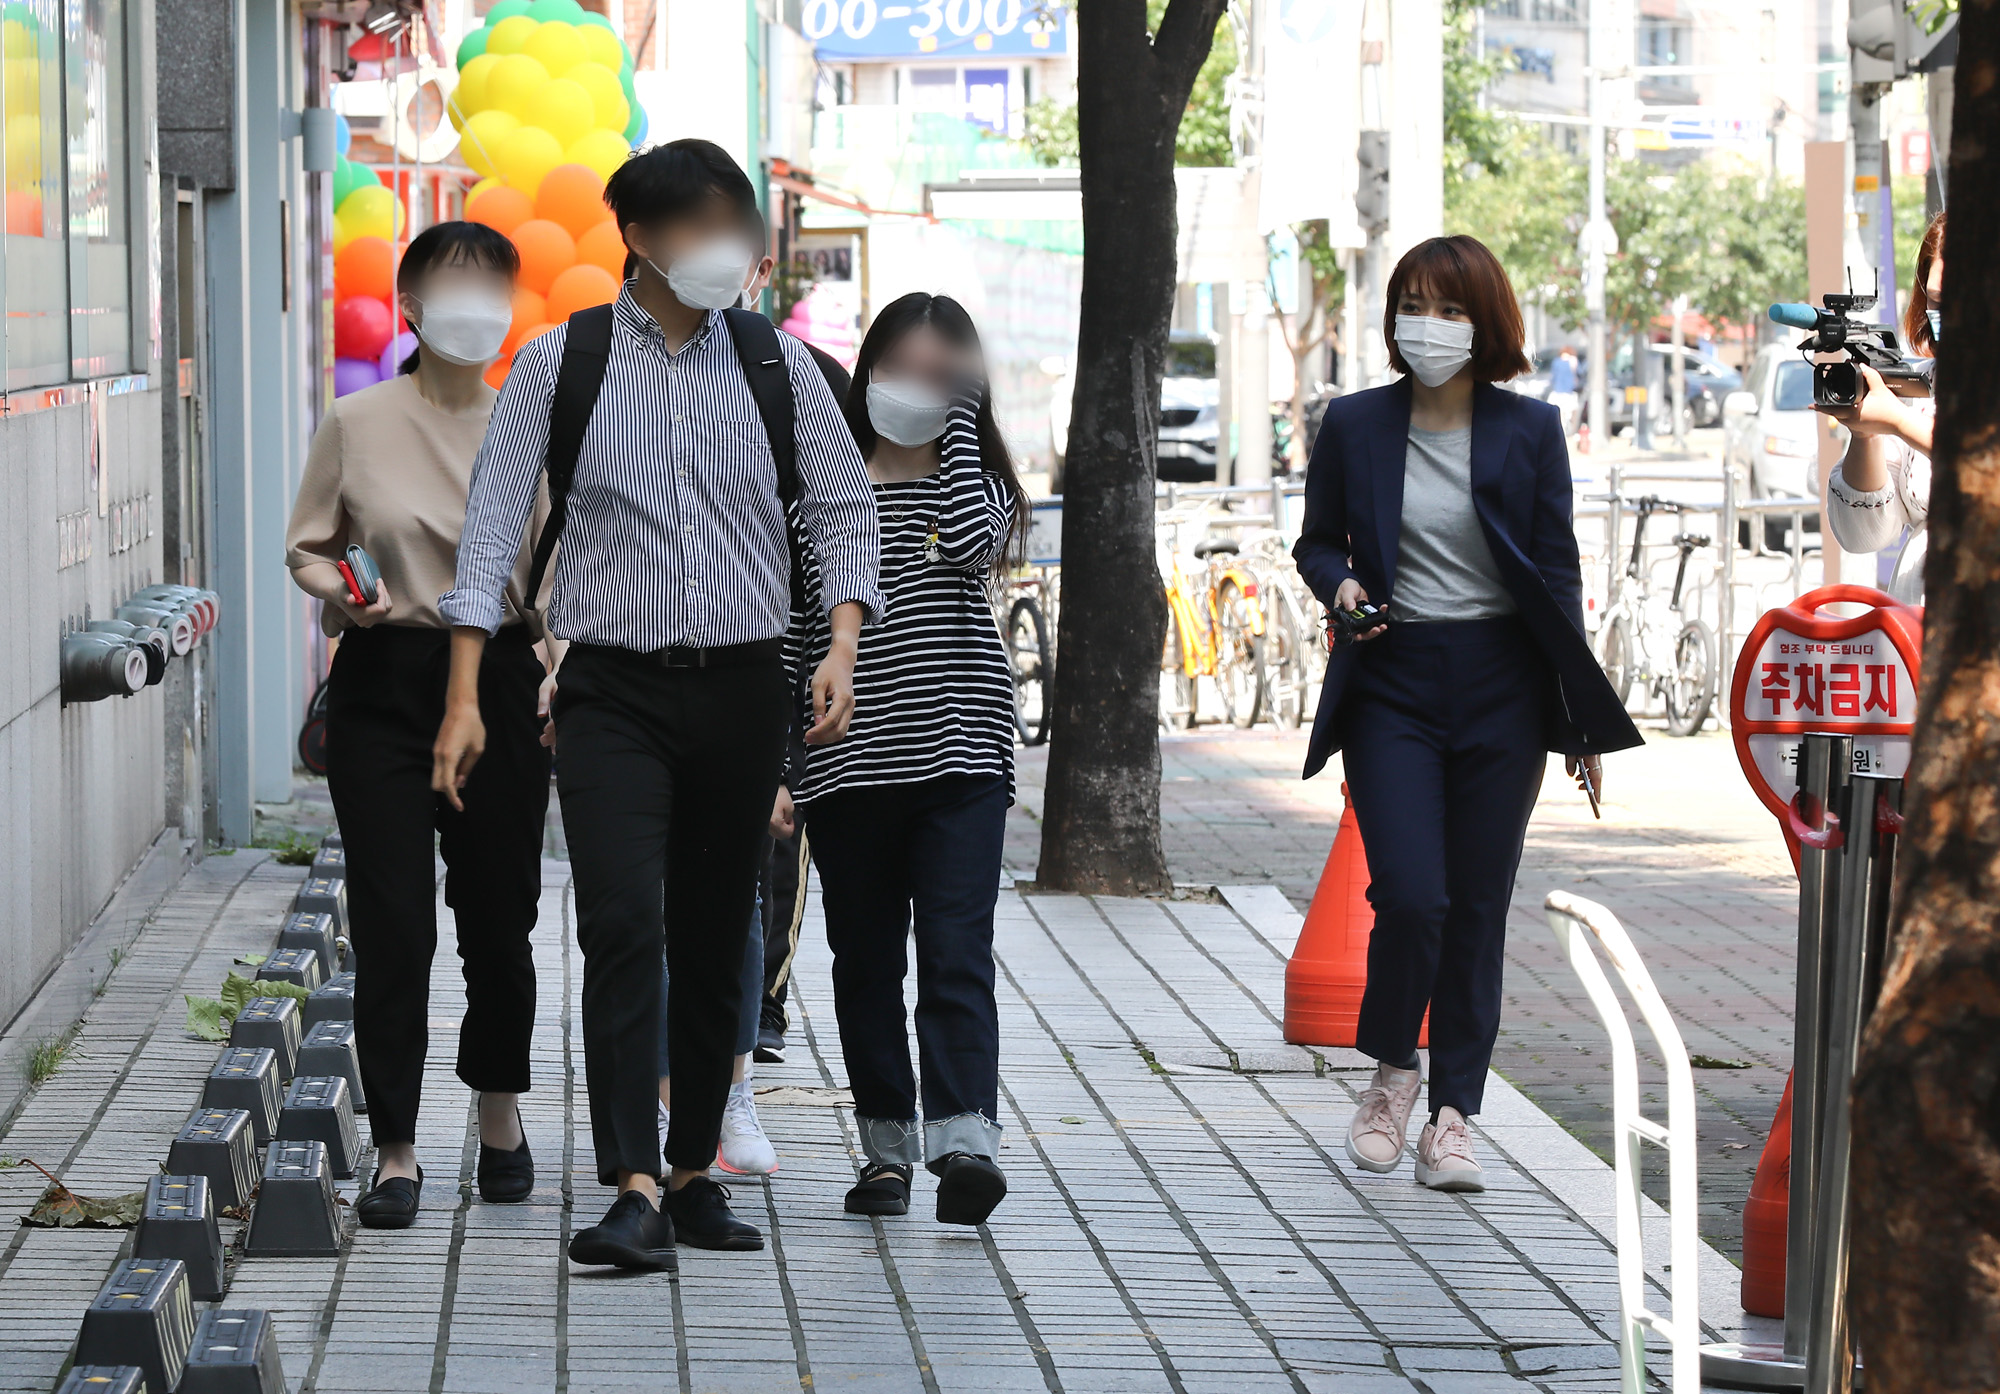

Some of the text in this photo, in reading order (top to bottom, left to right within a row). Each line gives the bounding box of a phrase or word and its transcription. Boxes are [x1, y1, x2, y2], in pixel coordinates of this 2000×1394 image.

[1780, 643, 1874, 655] 협조 부탁 드립니다
[1761, 663, 1897, 717] 주차금지
